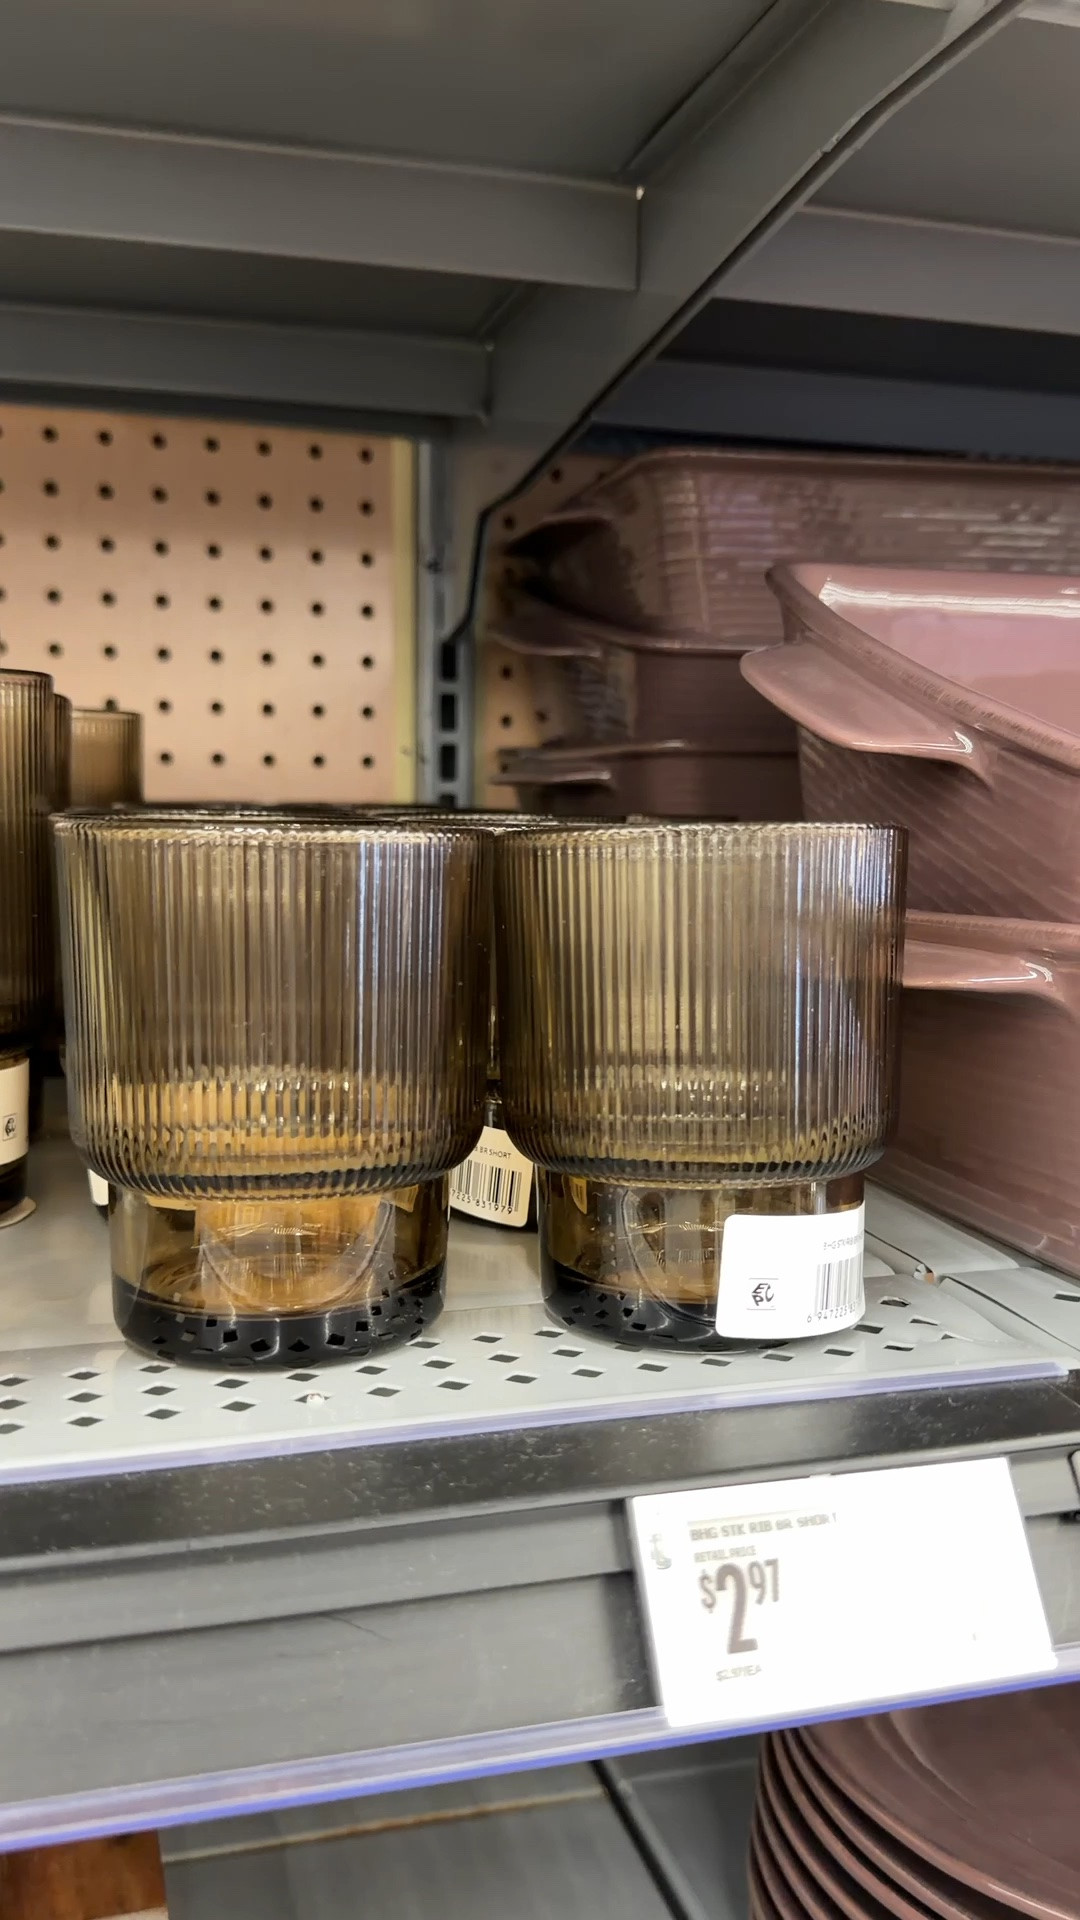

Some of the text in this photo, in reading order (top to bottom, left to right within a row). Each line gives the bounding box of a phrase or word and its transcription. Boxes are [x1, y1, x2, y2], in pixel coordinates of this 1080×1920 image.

[489, 1149, 512, 1159] SHORT
[689, 1526, 719, 1541] BHG
[721, 1523, 746, 1537] STK
[748, 1519, 773, 1534] RIB
